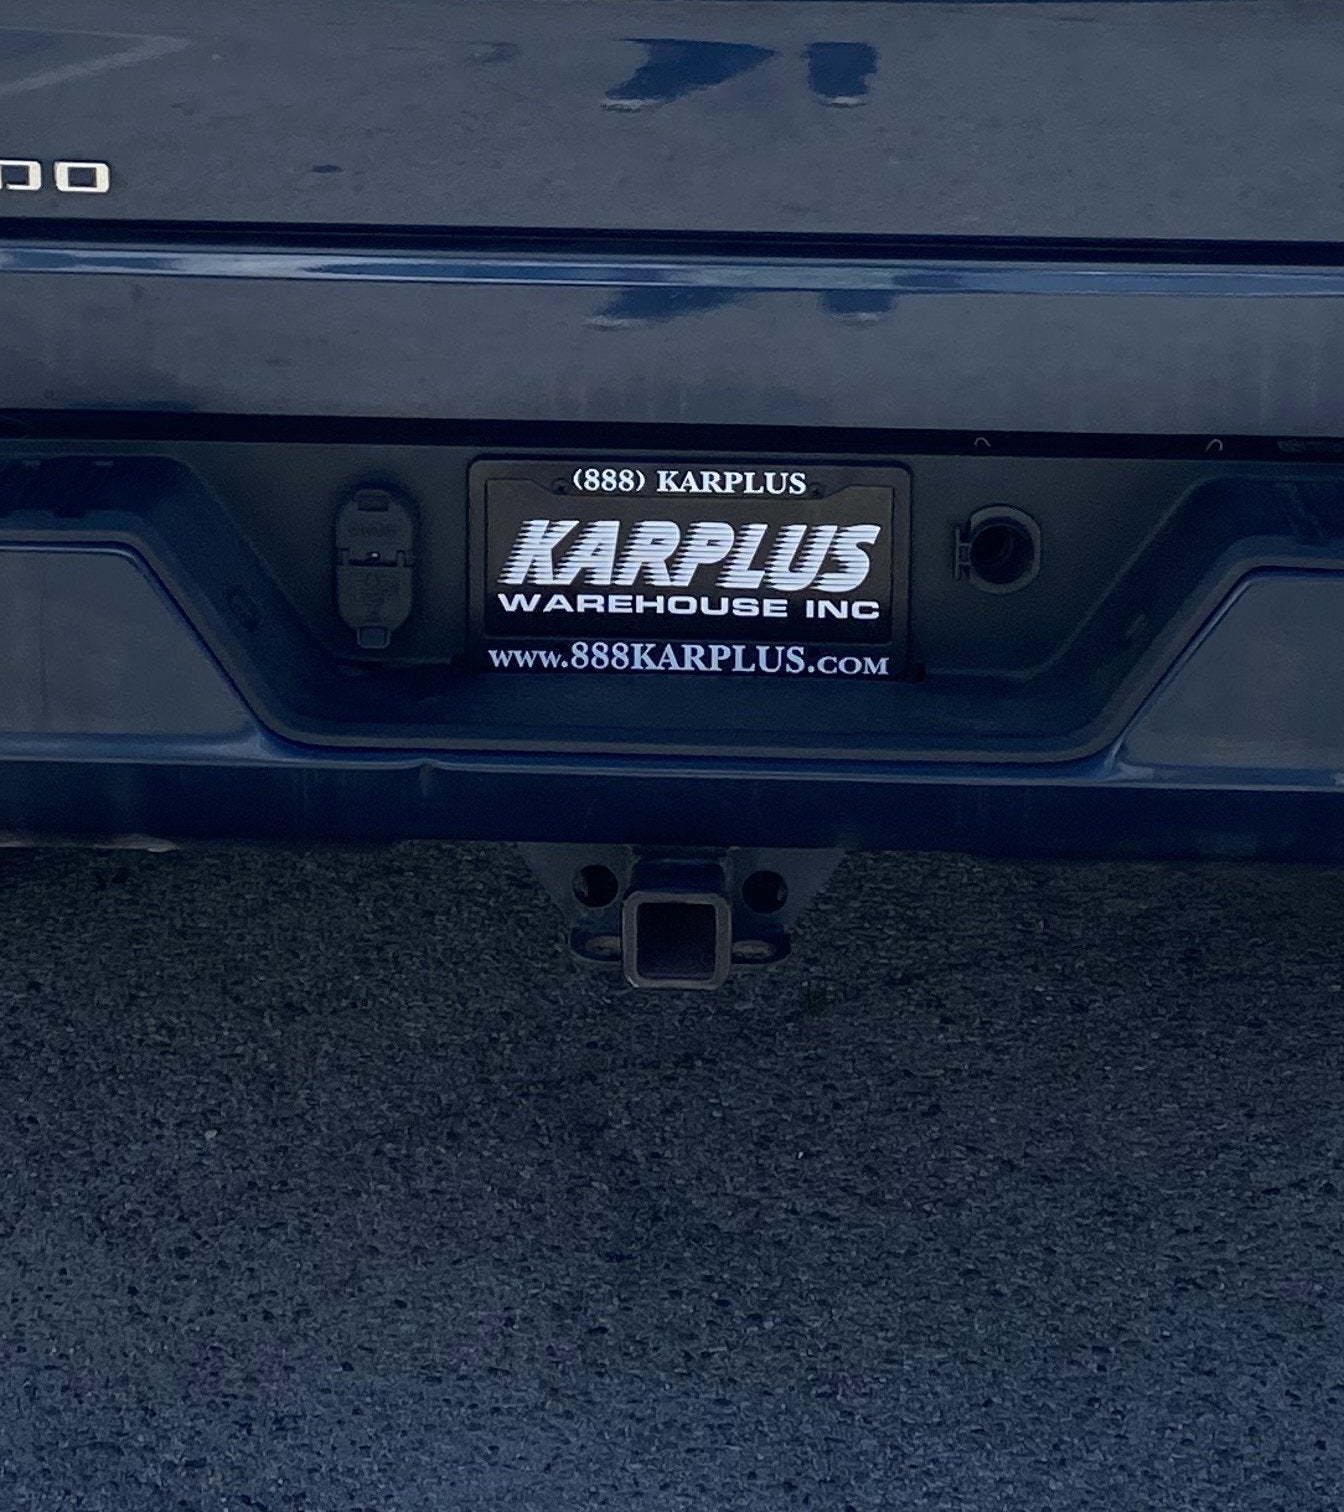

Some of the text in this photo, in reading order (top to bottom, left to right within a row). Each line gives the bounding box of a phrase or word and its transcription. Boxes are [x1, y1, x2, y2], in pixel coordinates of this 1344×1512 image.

[572, 467, 807, 495] (888) KARPLUS
[497, 519, 882, 593] KARPLUS
[497, 593, 881, 620] WAREHOUSE INC
